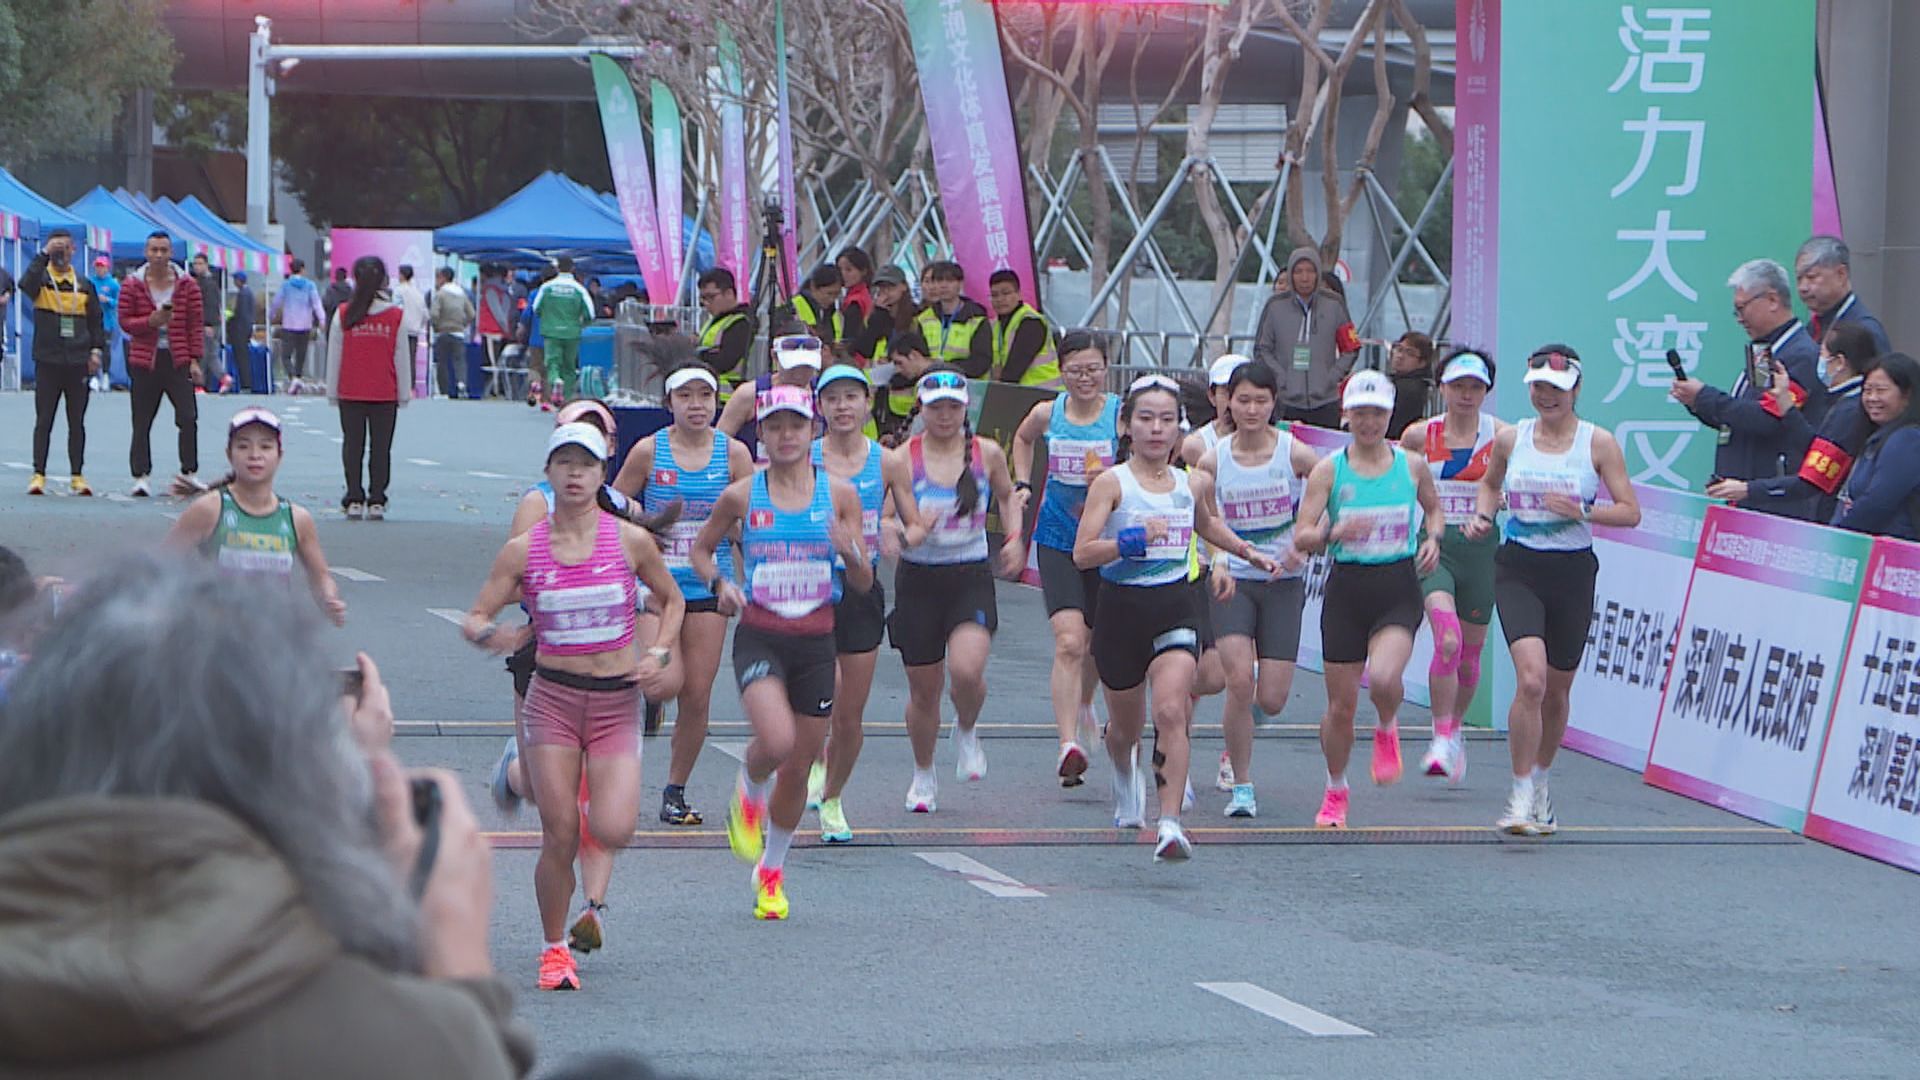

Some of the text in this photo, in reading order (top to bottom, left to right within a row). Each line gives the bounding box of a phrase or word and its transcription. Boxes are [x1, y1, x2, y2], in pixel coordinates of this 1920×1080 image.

[1603, 5, 1712, 488] 活力大湾区
[1673, 624, 1824, 752] 深圳市人民政府
[1848, 723, 1920, 816] 深圳赛区
